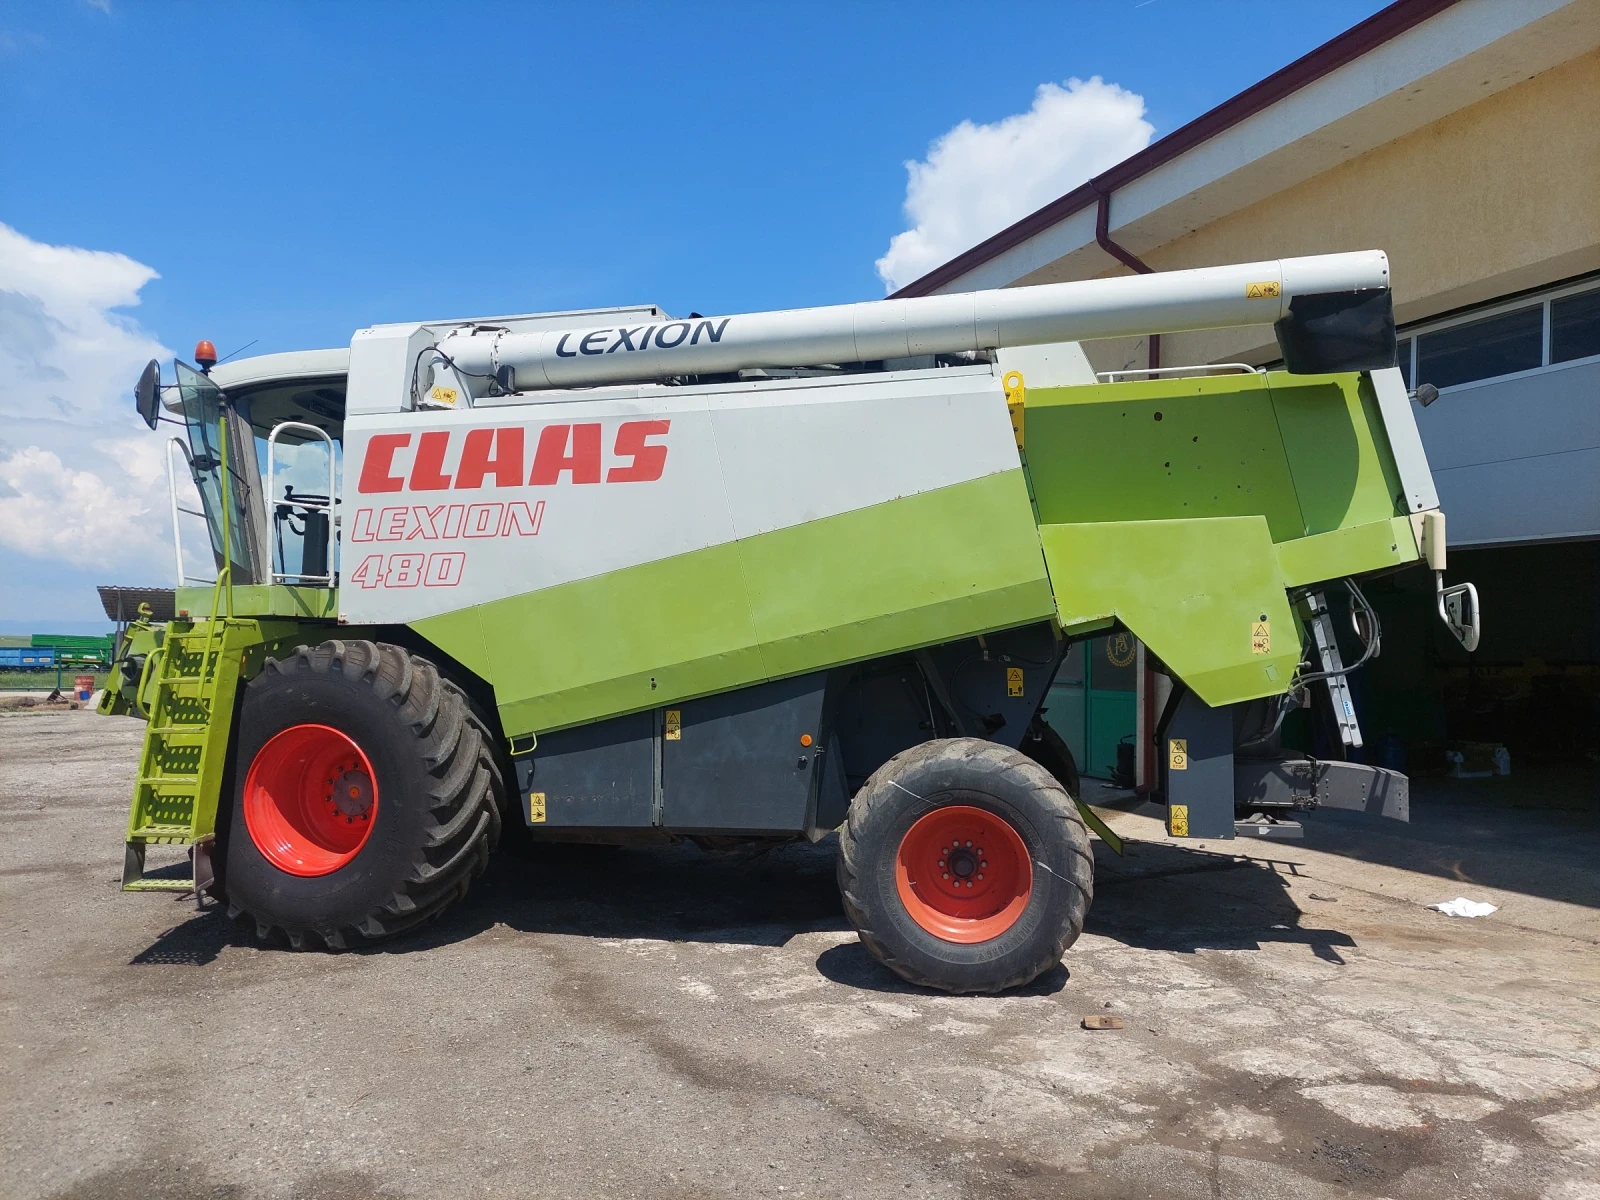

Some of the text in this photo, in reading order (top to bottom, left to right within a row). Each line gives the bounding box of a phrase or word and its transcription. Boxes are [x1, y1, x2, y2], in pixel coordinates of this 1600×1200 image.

[555, 318, 731, 358] LEXION
[357, 419, 671, 494] CLAAS
[351, 500, 546, 542] LEXION
[351, 552, 466, 589] 480
